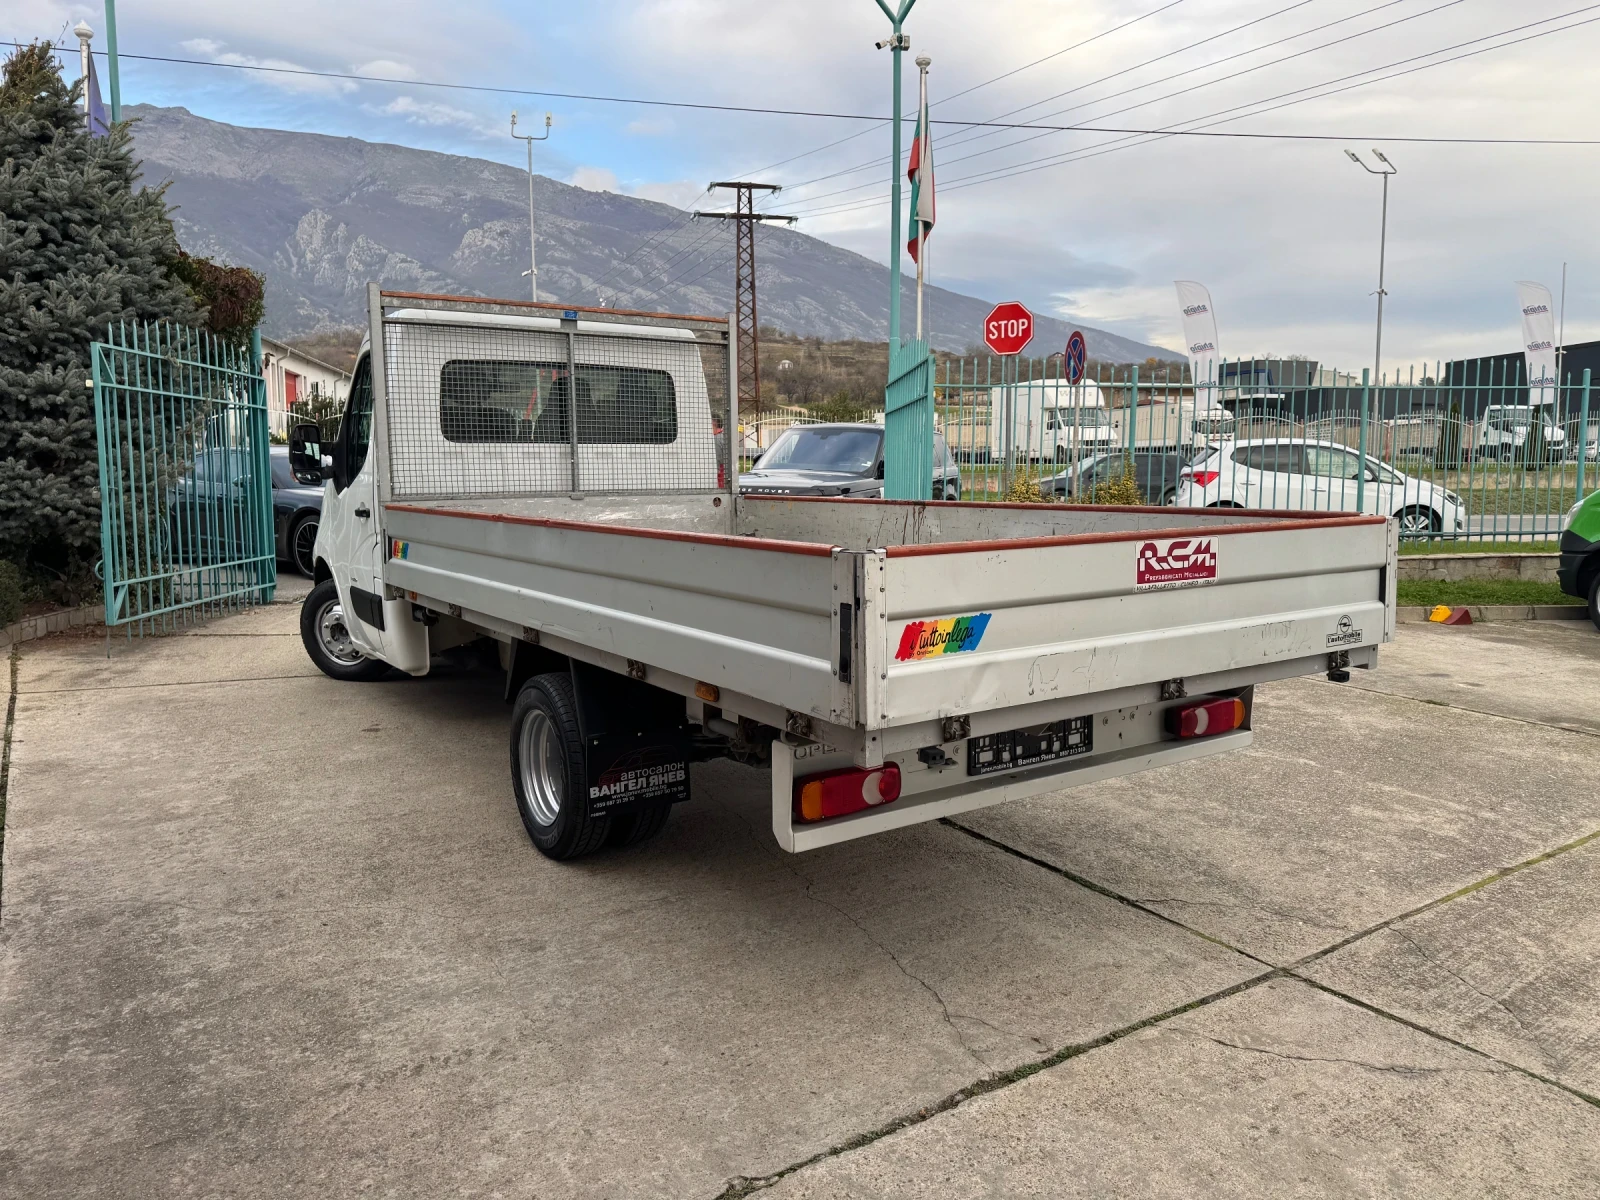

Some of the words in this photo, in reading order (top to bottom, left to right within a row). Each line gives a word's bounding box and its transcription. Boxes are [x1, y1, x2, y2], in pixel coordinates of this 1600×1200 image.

[989, 318, 1028, 340] STOP
[1018, 756, 1040, 766] Вангел
[1041, 753, 1056, 762] Янев
[620, 761, 685, 781] автосалон
[589, 778, 646, 799] ВАНГЕЛ
[649, 769, 686, 787] ЯНЕВ
